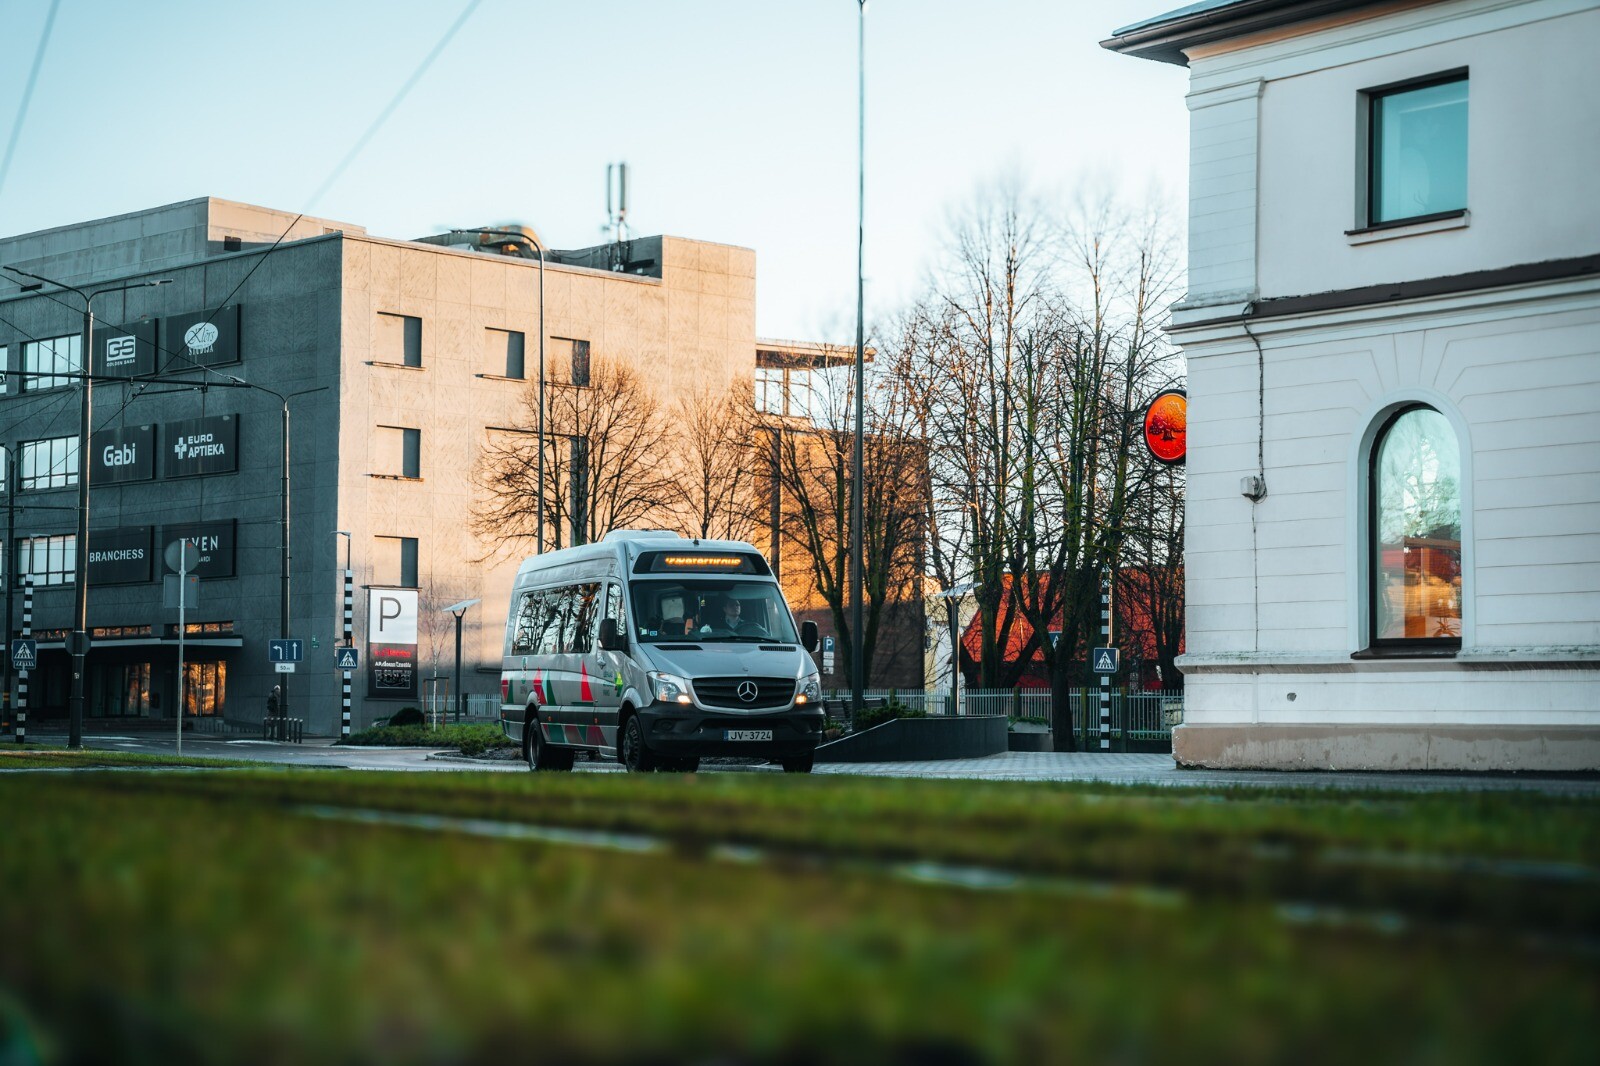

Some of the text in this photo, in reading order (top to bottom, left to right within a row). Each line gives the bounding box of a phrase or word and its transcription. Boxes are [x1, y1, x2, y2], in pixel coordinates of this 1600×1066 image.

[188, 433, 213, 444] EURO
[103, 443, 136, 467] Gabi
[188, 443, 225, 458] APTIEKA
[89, 548, 144, 562] BRANCHESS
[379, 596, 402, 632] P
[826, 638, 833, 650] P
